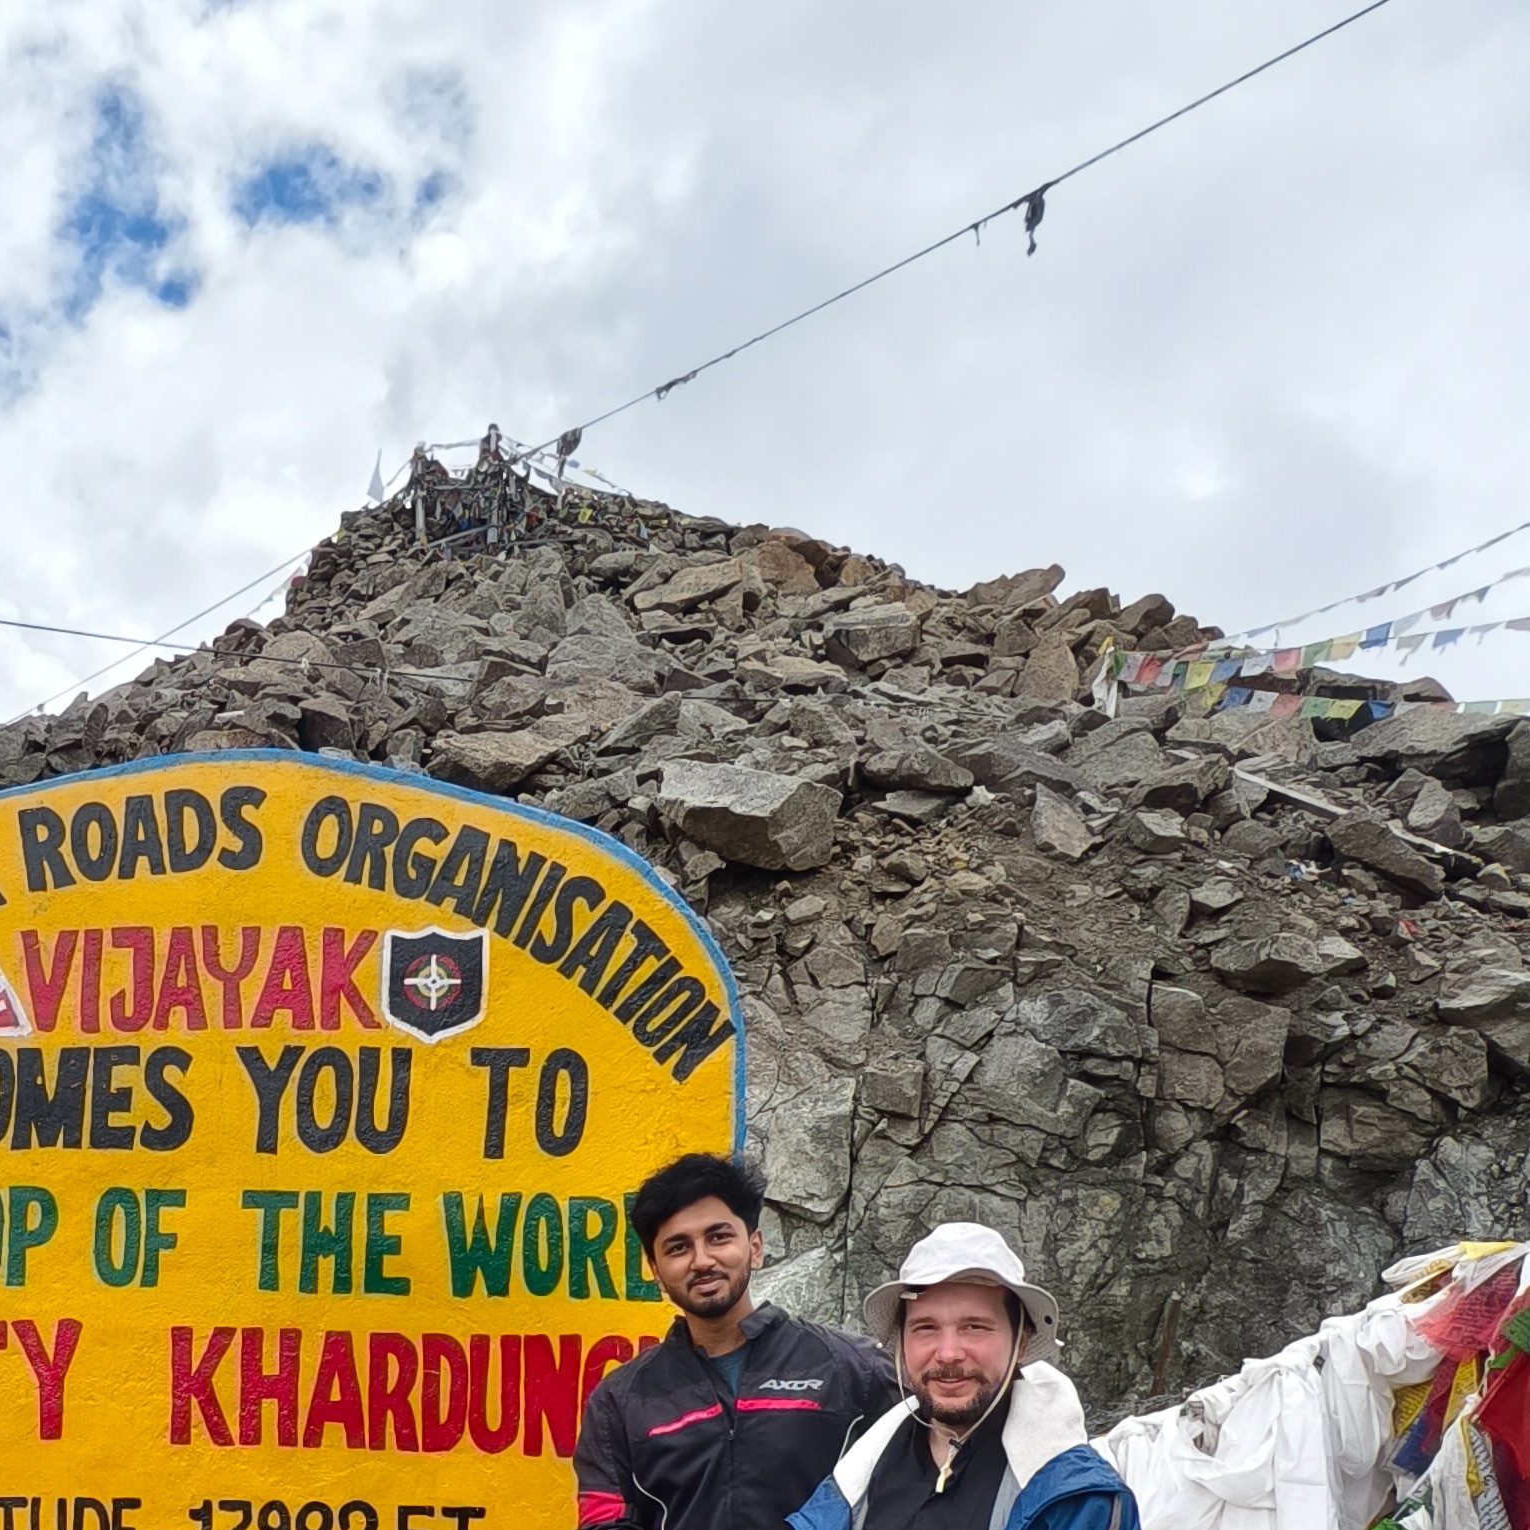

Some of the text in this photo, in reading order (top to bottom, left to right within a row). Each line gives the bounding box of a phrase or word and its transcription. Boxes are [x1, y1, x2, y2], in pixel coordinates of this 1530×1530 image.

[18, 786, 267, 892] ROADS
[302, 796, 737, 1085] ORGANISATION
[21, 925, 382, 1033] VIJAYAK
[236, 1046, 412, 1156] YOU
[471, 1047, 589, 1159] TO
[95, 1187, 186, 1287] OF
[241, 1190, 411, 1296] THE
[443, 1191, 663, 1302] WORL
[171, 1326, 659, 1458] KHARDUN
